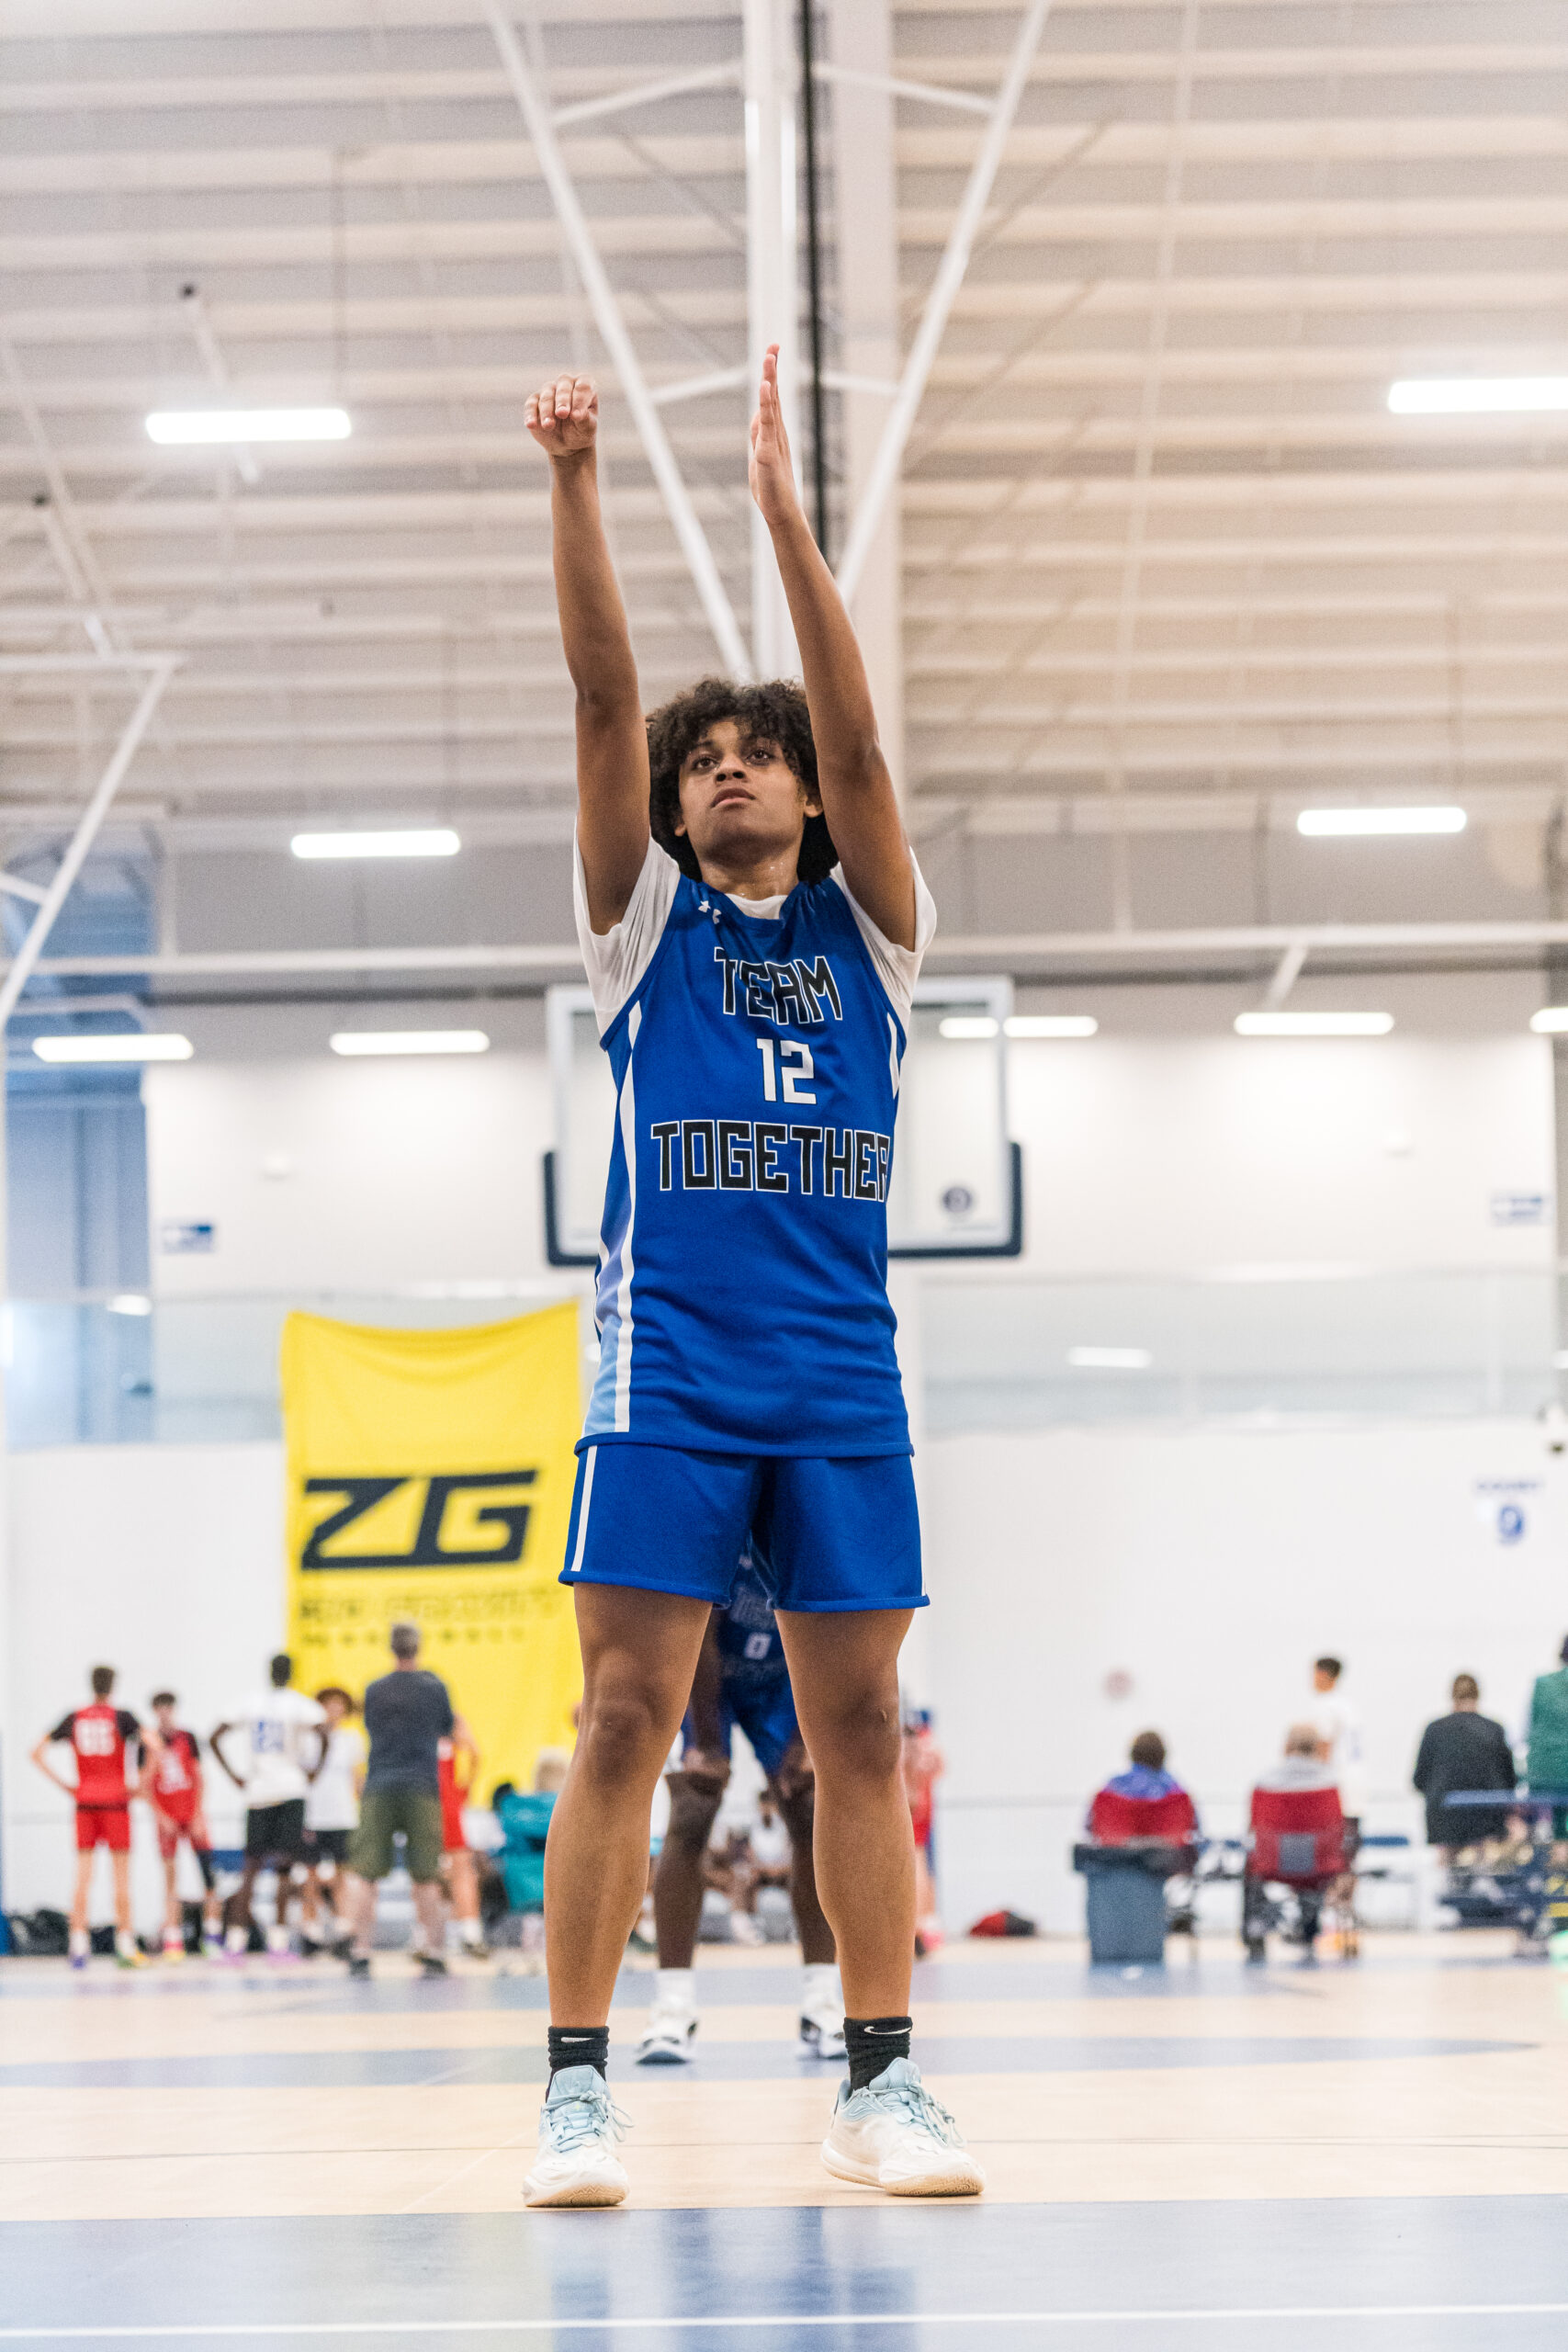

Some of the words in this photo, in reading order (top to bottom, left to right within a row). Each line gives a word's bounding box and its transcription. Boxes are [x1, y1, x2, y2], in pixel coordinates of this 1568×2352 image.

[714, 946, 843, 1025] TEAM
[756, 1037, 818, 1104] 12
[650, 1119, 891, 1203] TOGETHER
[300, 1468, 539, 1571] ZG
